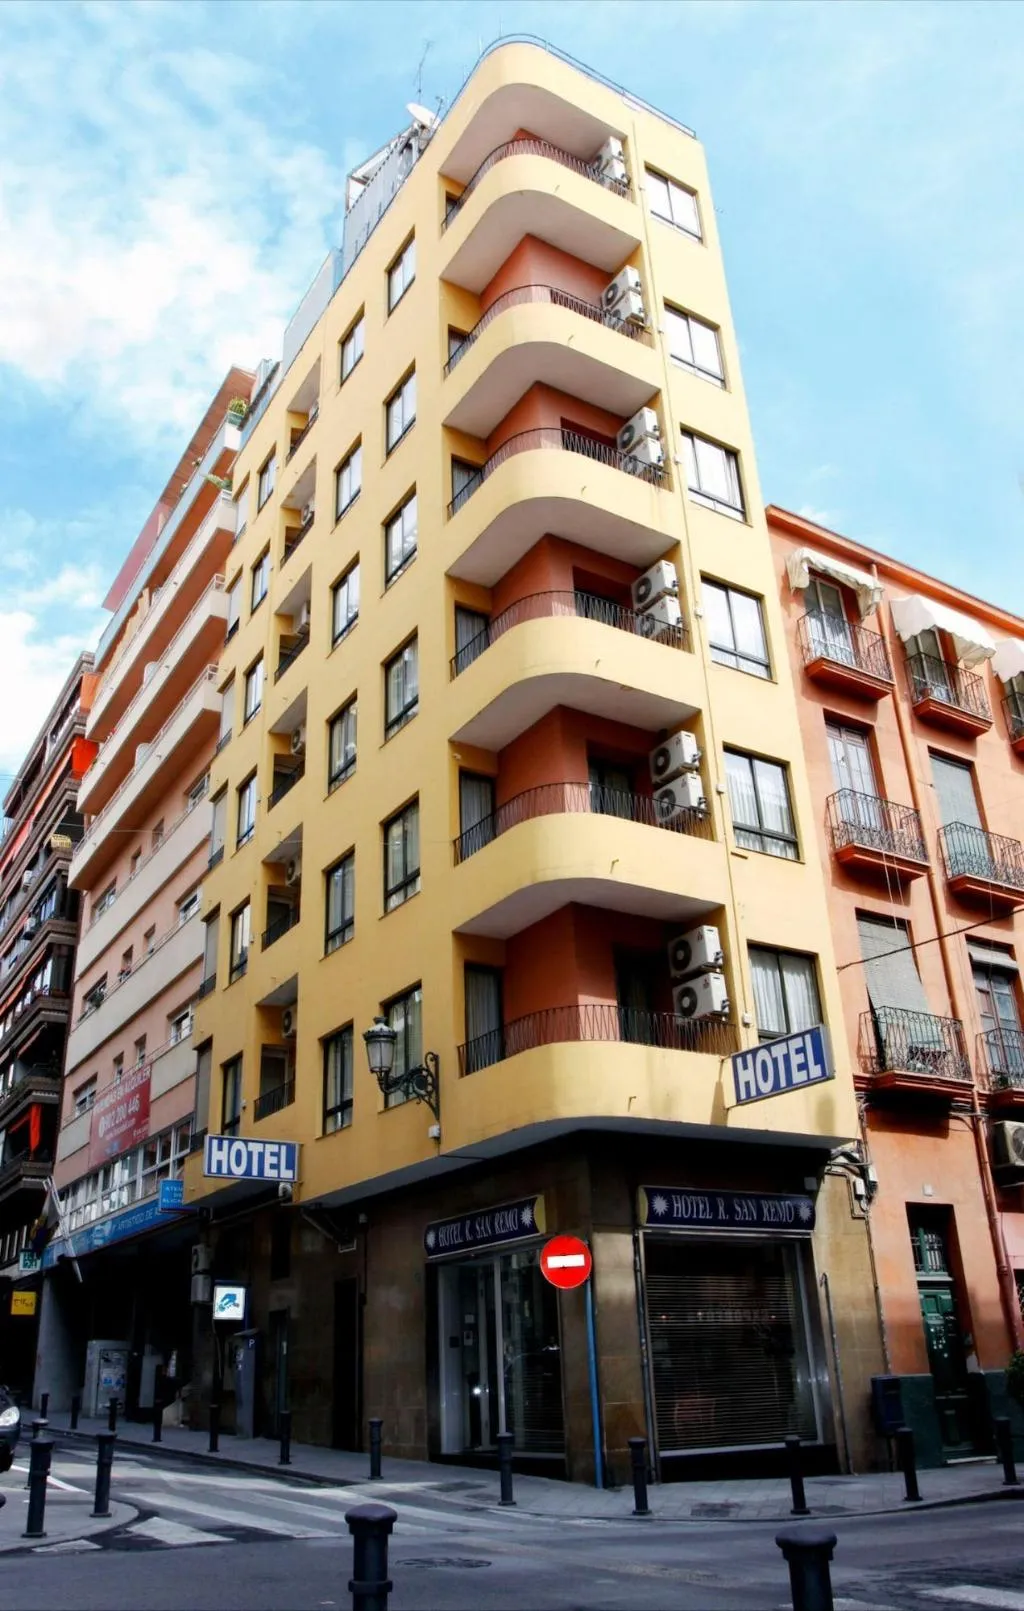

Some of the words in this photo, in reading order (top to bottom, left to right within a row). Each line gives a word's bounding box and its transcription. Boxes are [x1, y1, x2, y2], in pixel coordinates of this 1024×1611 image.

[736, 1033, 822, 1101] HOTEL
[210, 1138, 294, 1179] HOTEL
[438, 1222, 463, 1247] HOTEL
[475, 1215, 492, 1239] SAN
[494, 1207, 518, 1235] REMO
[672, 1194, 713, 1219] HOTEL
[716, 1197, 729, 1220] R.
[734, 1199, 757, 1221] SAN
[762, 1200, 795, 1223] REMO
